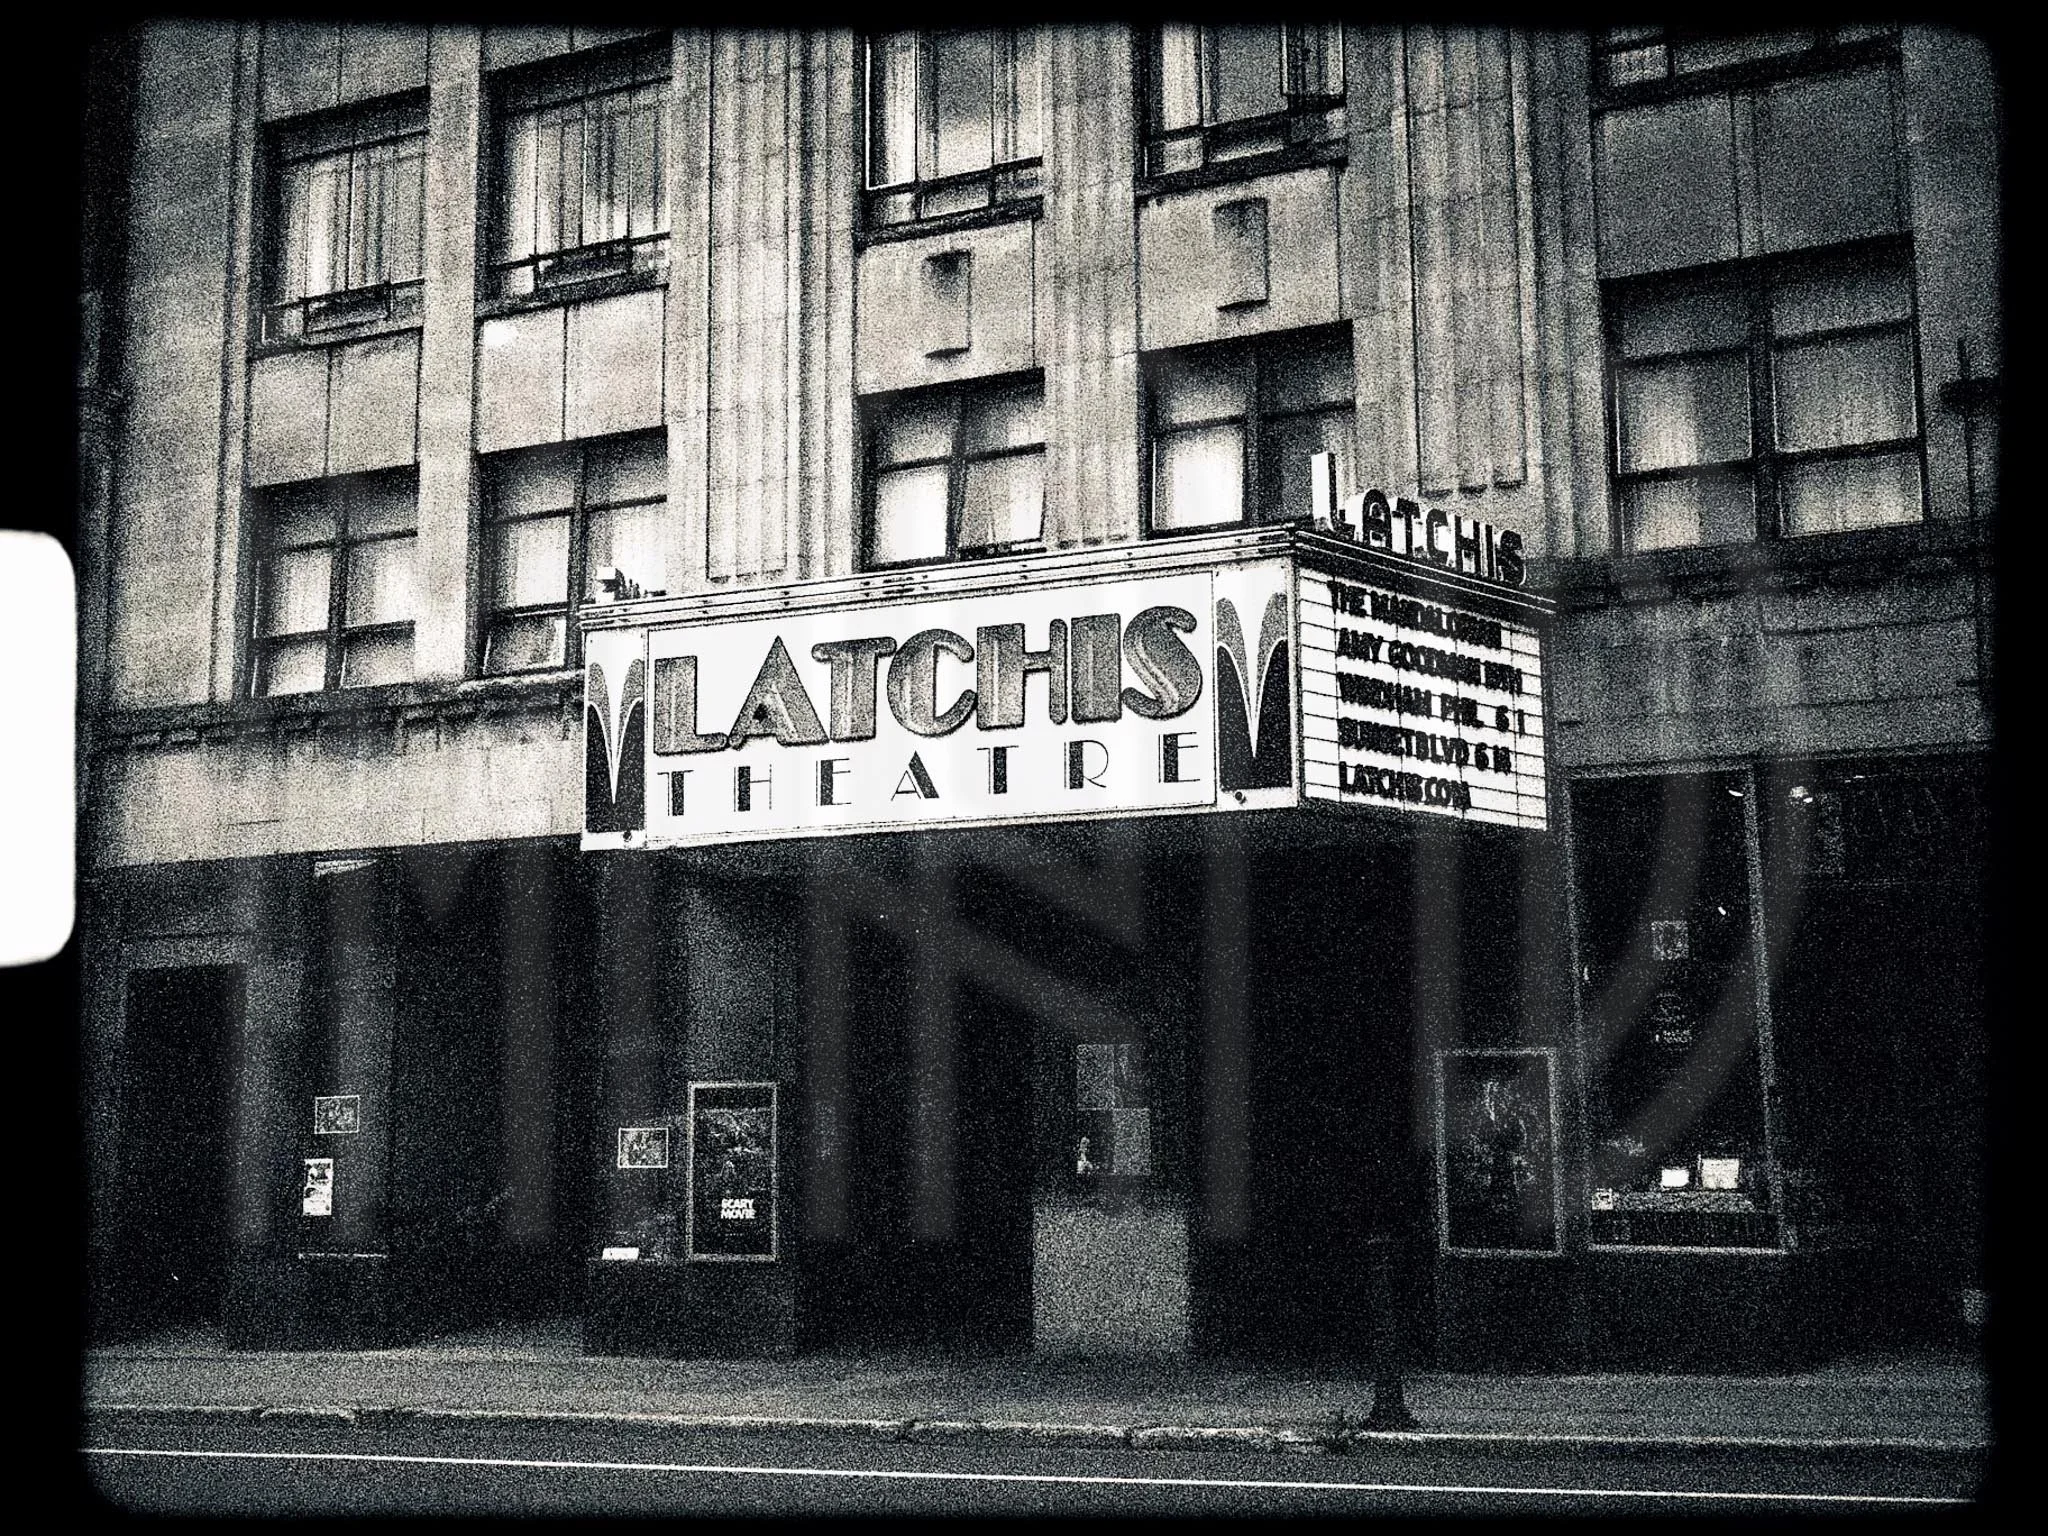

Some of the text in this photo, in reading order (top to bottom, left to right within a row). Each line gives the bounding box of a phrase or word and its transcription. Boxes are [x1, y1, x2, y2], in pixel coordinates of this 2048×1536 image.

[1311, 451, 1526, 587] LATCHIS
[1327, 580, 1501, 650] THE MANDALO
[1338, 628, 1383, 664] AMY
[653, 606, 1202, 756] LATCHIS
[657, 732, 1200, 816] THEATRE
[720, 1208, 757, 1220] MOVIE
[721, 1198, 754, 1209] SCARY
